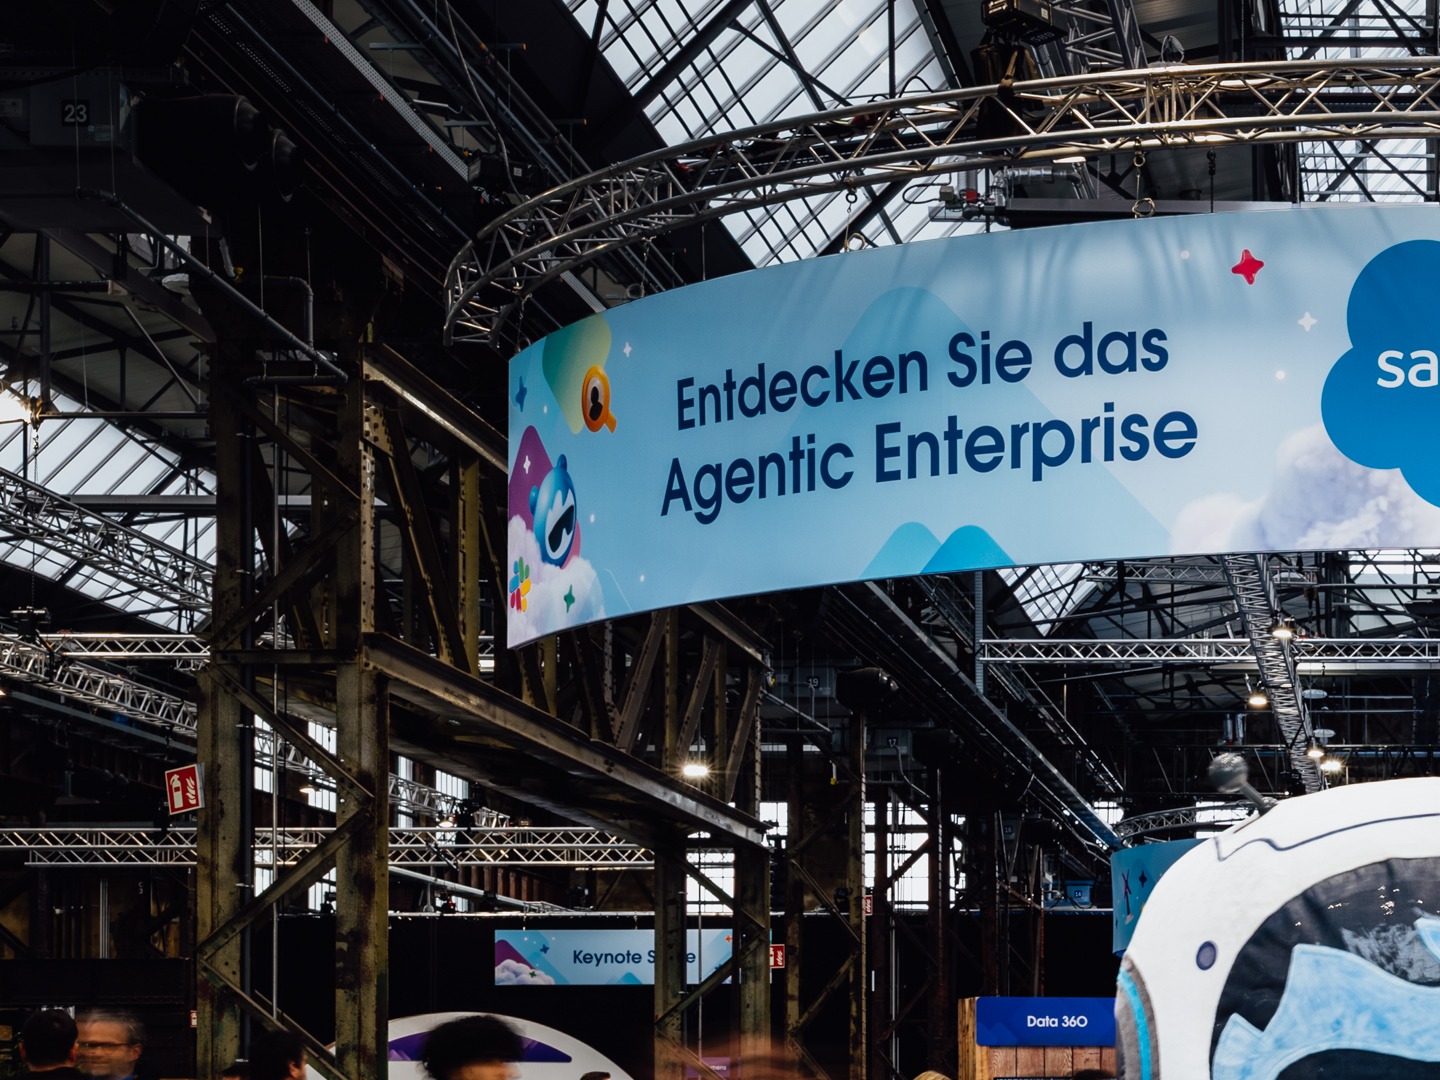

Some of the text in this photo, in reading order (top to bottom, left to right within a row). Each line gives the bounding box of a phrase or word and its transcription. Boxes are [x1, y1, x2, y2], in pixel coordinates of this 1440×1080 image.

[64, 104, 88, 123] 23
[676, 321, 1169, 431] Entdecken Sie das
[660, 401, 1198, 525] Agentic Enterprise
[573, 949, 642, 967] Keynote
[1027, 1015, 1088, 1028] Data 360
